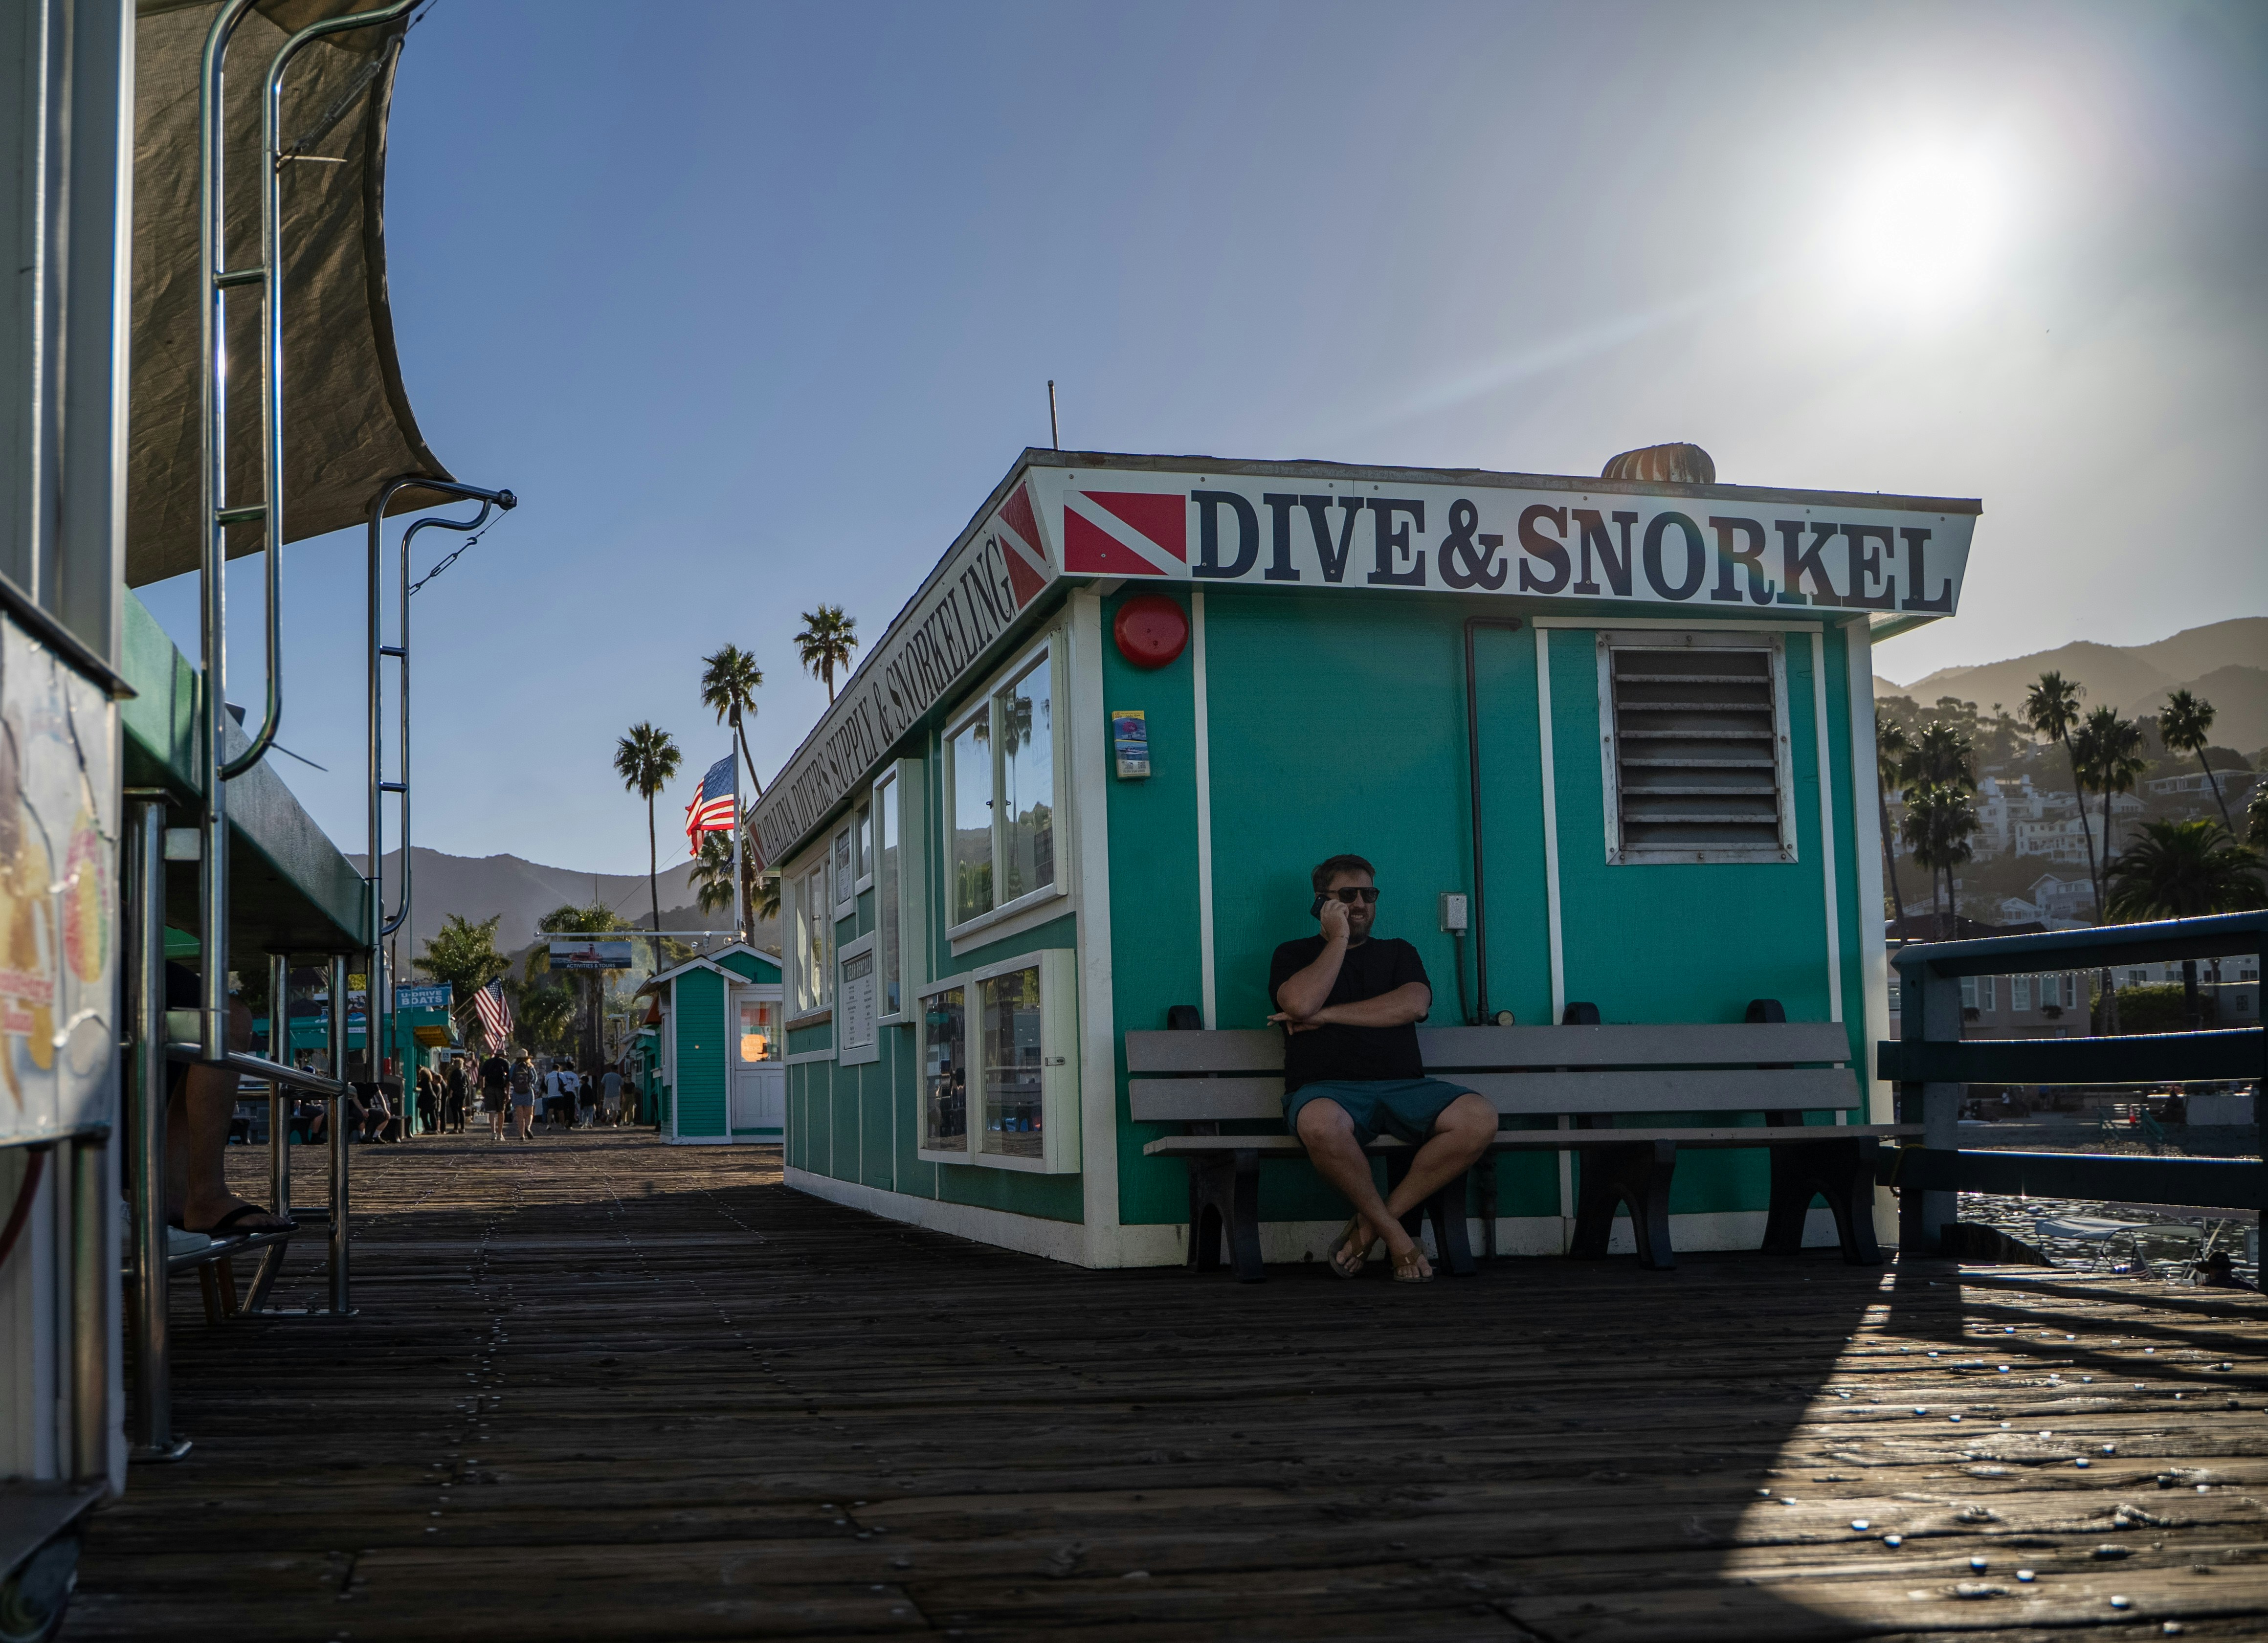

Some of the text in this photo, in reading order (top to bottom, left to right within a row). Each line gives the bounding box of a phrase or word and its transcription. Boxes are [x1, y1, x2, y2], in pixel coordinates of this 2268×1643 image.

[1191, 489, 1426, 587] DIVE
[1517, 504, 1953, 613] SNORKEL
[757, 533, 1016, 866] CATALINA DIVERS SUPPLY & SNORKELING
[401, 996, 443, 1005] BOATS
